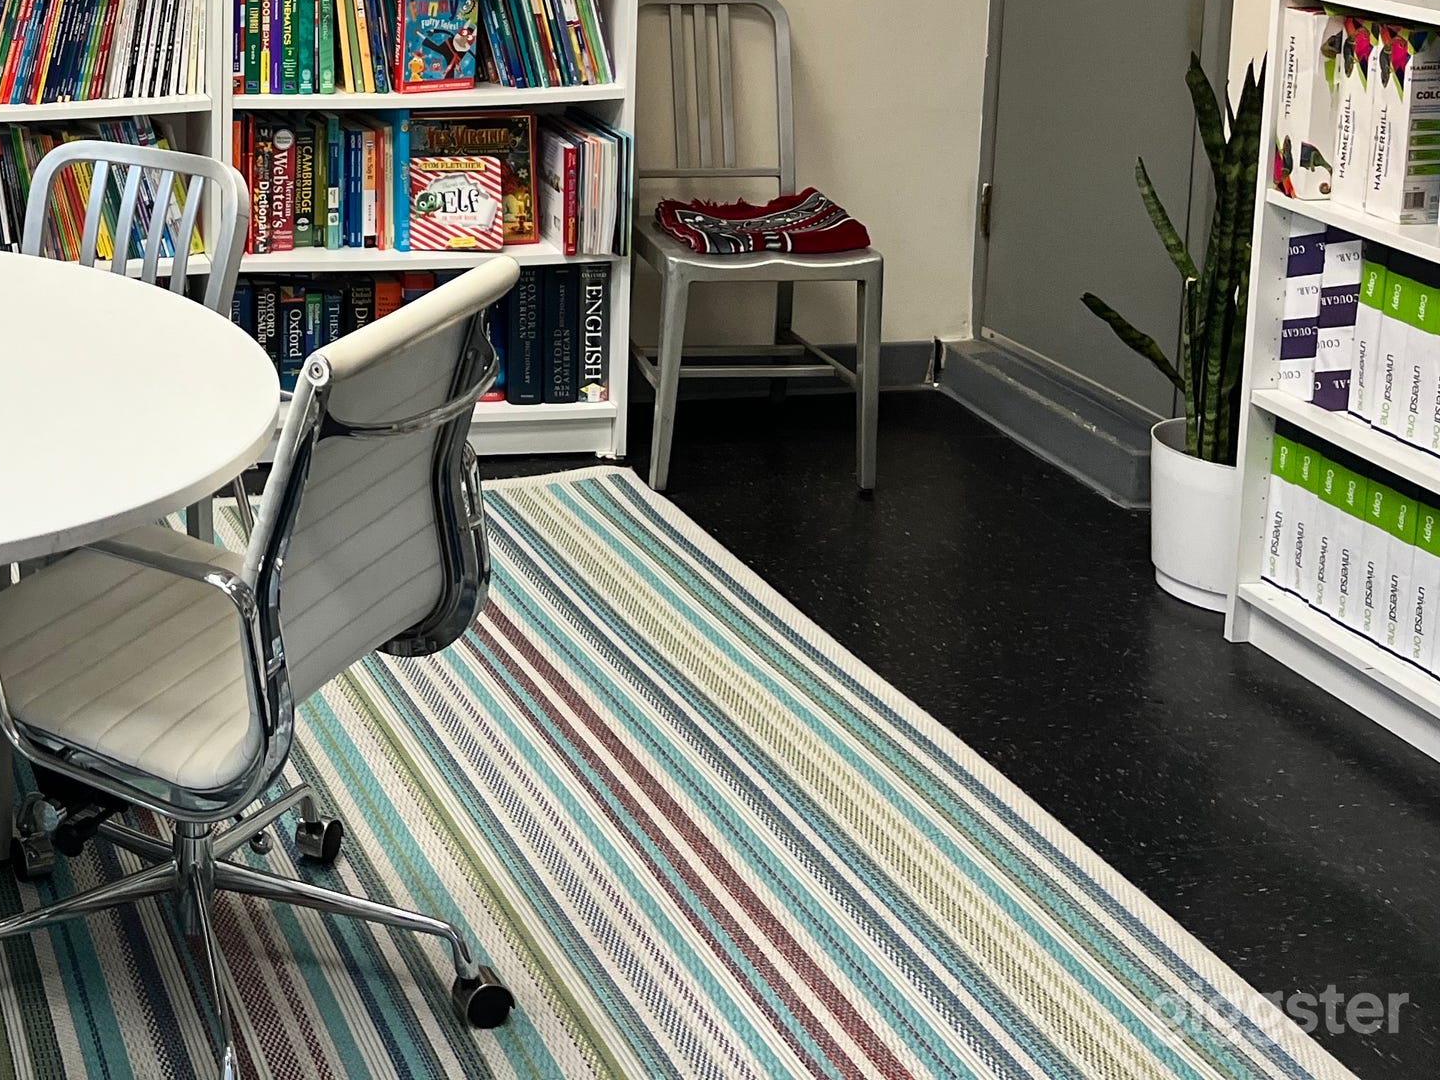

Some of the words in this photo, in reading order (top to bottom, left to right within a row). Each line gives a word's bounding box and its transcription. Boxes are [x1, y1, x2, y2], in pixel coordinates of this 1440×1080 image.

[1283, 35, 1296, 119] HAMMERMILL
[1339, 94, 1353, 180] HAMMERMILL
[1373, 104, 1388, 191] HAMMERMILL
[271, 150, 289, 229] Webster's
[301, 146, 313, 214] CAMBRIDGE
[423, 161, 440, 169] TOM
[440, 161, 482, 169] FLETCHER
[258, 181, 271, 242] Dictionary
[285, 180, 294, 217] Merriam
[1367, 271, 1378, 298] Copy
[1392, 284, 1402, 311] Copy
[1418, 294, 1428, 322] Copy
[266, 293, 276, 338] OXFORD
[289, 309, 302, 358] Oxford
[328, 304, 341, 342] THESA
[519, 284, 527, 339] AMERICAN
[527, 283, 537, 339] OXFORD
[584, 285, 603, 380] ENGLISH
[553, 329, 562, 384] OXFORD
[1384, 353, 1394, 403] universal
[1380, 402, 1390, 426] one
[1410, 365, 1421, 415] universal
[1279, 446, 1289, 471] Copy
[1326, 468, 1335, 496] Copy
[1270, 510, 1284, 558] universal
[1317, 536, 1329, 584] universal
